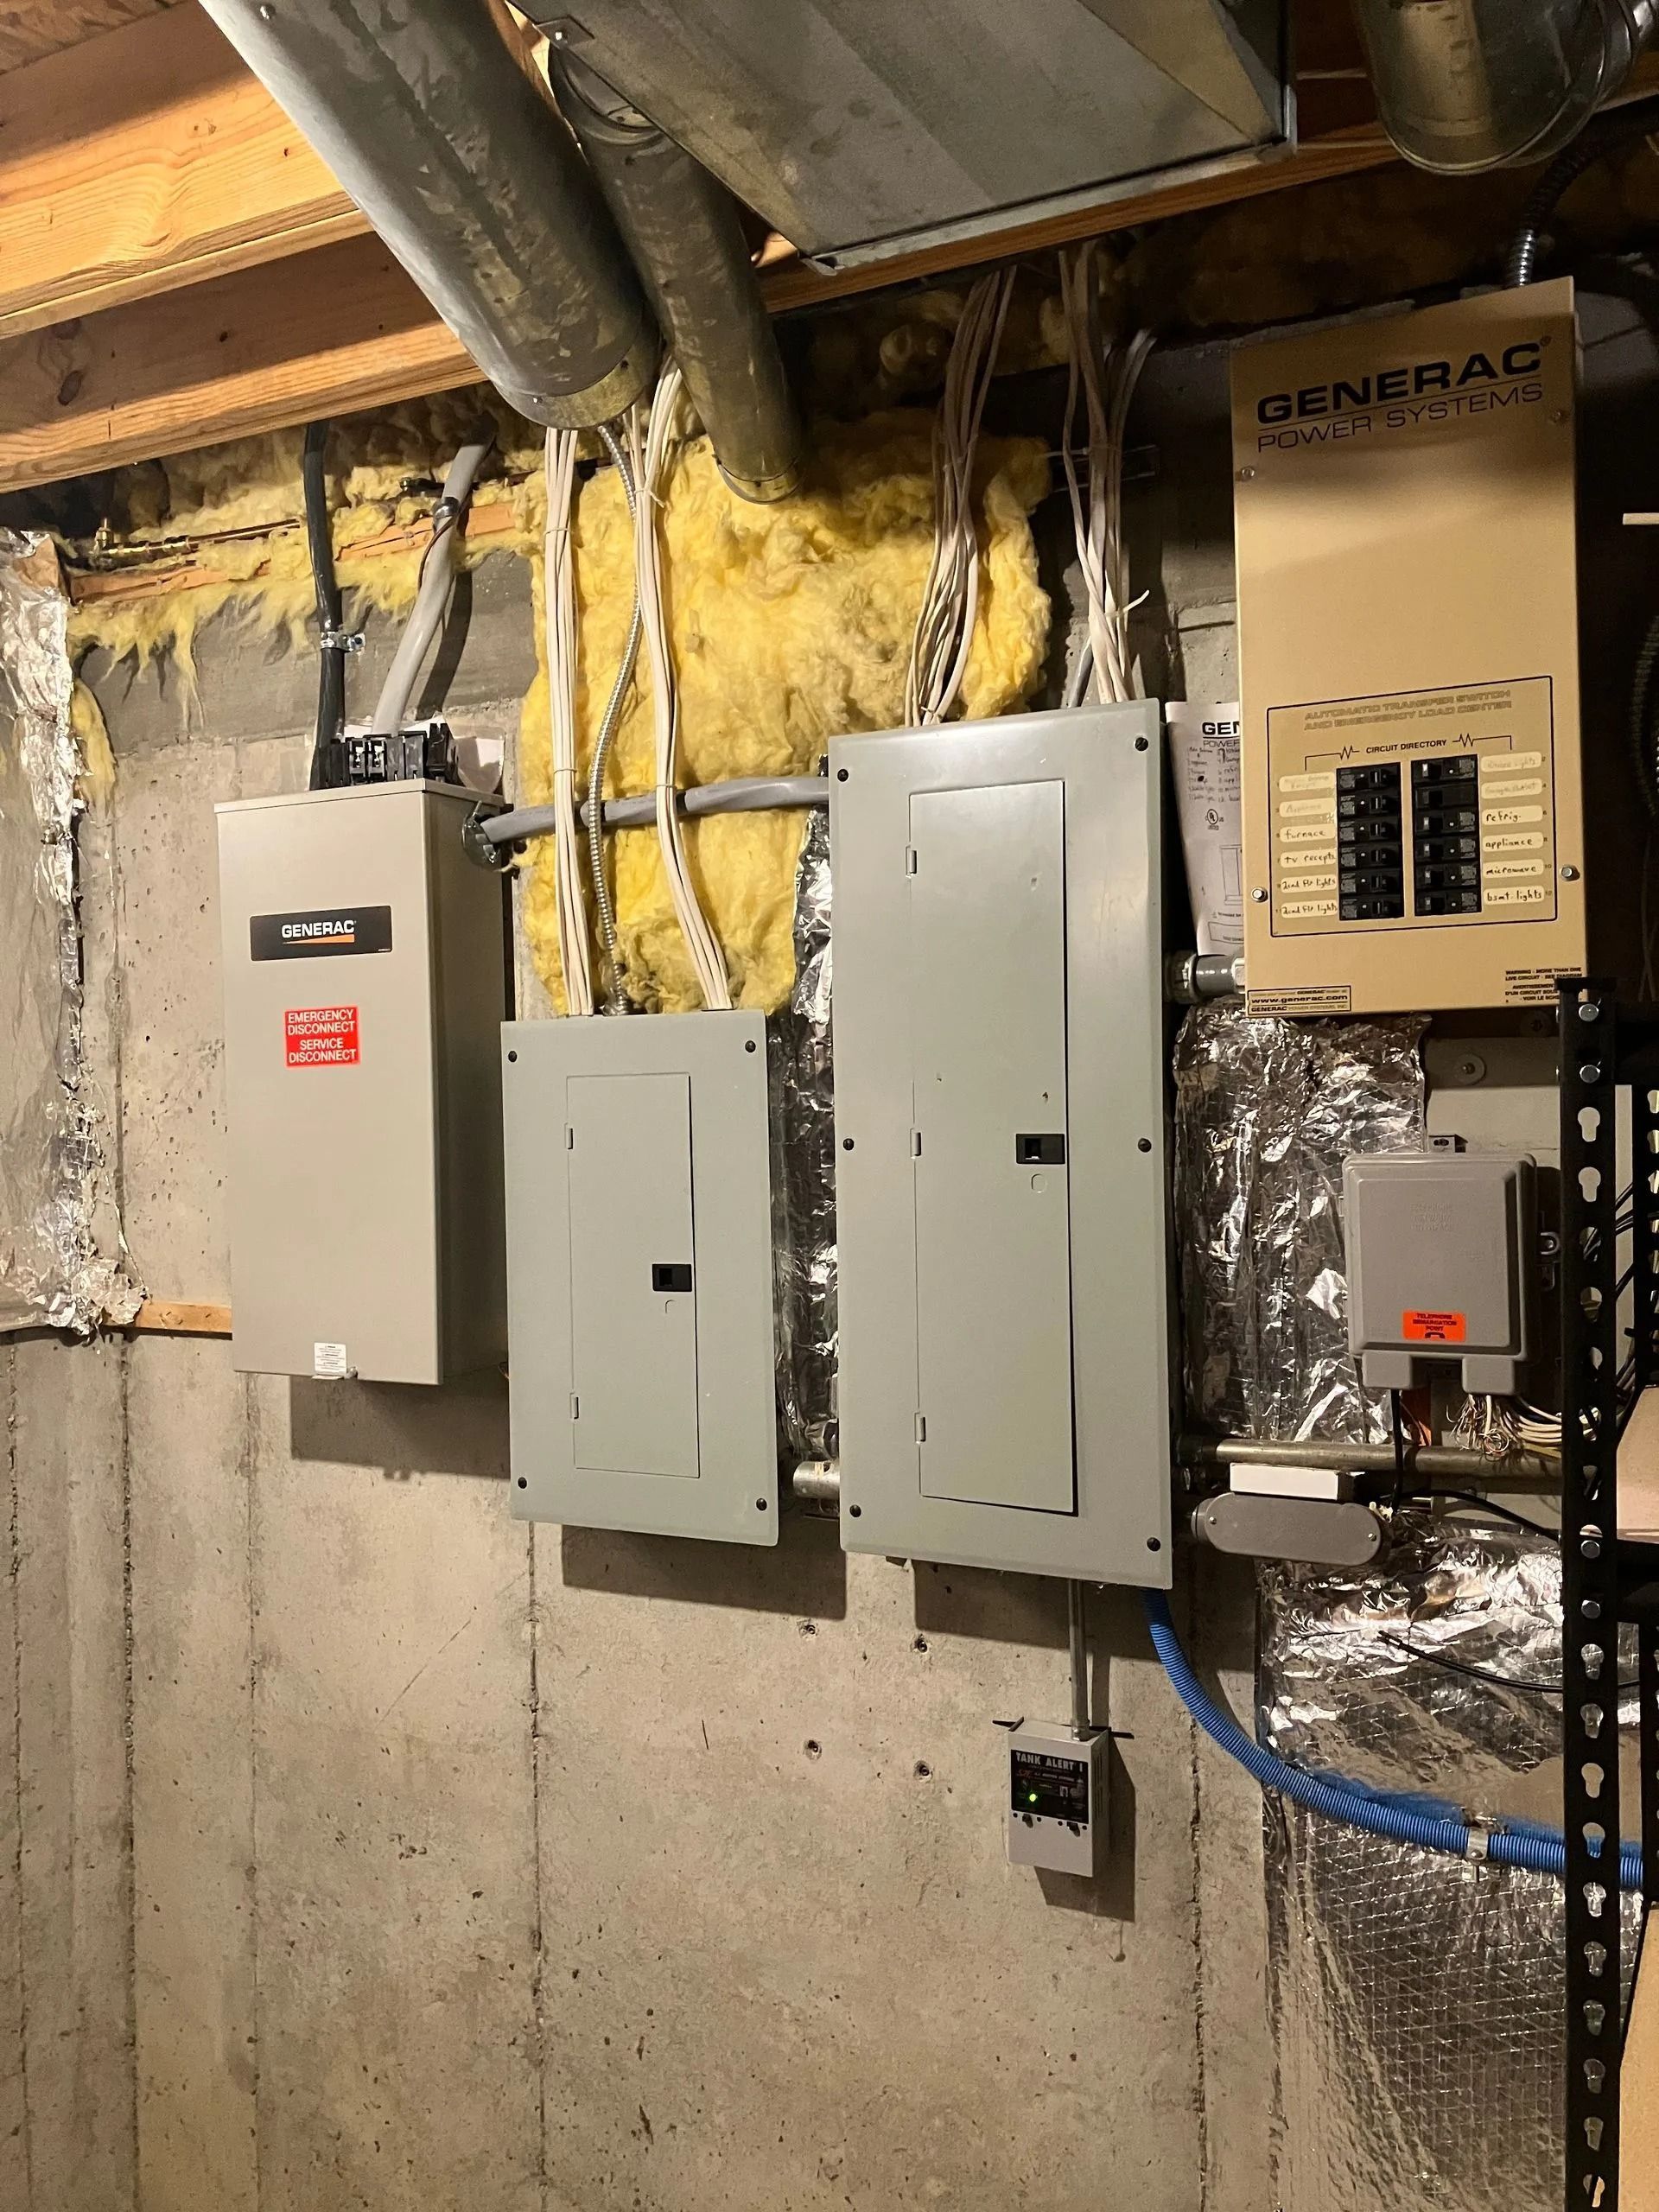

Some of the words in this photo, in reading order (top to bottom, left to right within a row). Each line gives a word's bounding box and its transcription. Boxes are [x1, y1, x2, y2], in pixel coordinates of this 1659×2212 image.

[1257, 342, 1541, 424] GENERAC
[1258, 416, 1372, 453] POWER
[1387, 383, 1543, 428] SYSTEMS
[1305, 704, 1382, 721] AUTOMATIC
[1382, 696, 1454, 710] TRANSFER
[1456, 690, 1510, 703] SWITCH
[1304, 719, 1333, 731] AND
[1334, 710, 1416, 728] EMERGENCY
[1418, 707, 1456, 719] LOAD
[1458, 700, 1512, 714] CENTER
[1366, 744, 1397, 754] CIRCUIT
[1401, 740, 1447, 750] DIRECTORY
[1285, 830, 1326, 840] furnace
[1485, 837, 1533, 849] appliance
[1486, 866, 1537, 875] microwave
[1516, 889, 1542, 901] lights
[281, 919, 355, 938] GENERAC
[1251, 995, 1348, 1004] www.generac.com
[288, 1009, 353, 1023] EMERGENCY
[288, 1021, 355, 1036] DISCONNECT
[300, 1038, 344, 1051] SERVICE
[289, 1049, 357, 1064] DISCONNECT
[1016, 1751, 1041, 1765] TANK
[1046, 1757, 1074, 1771] ALERT
